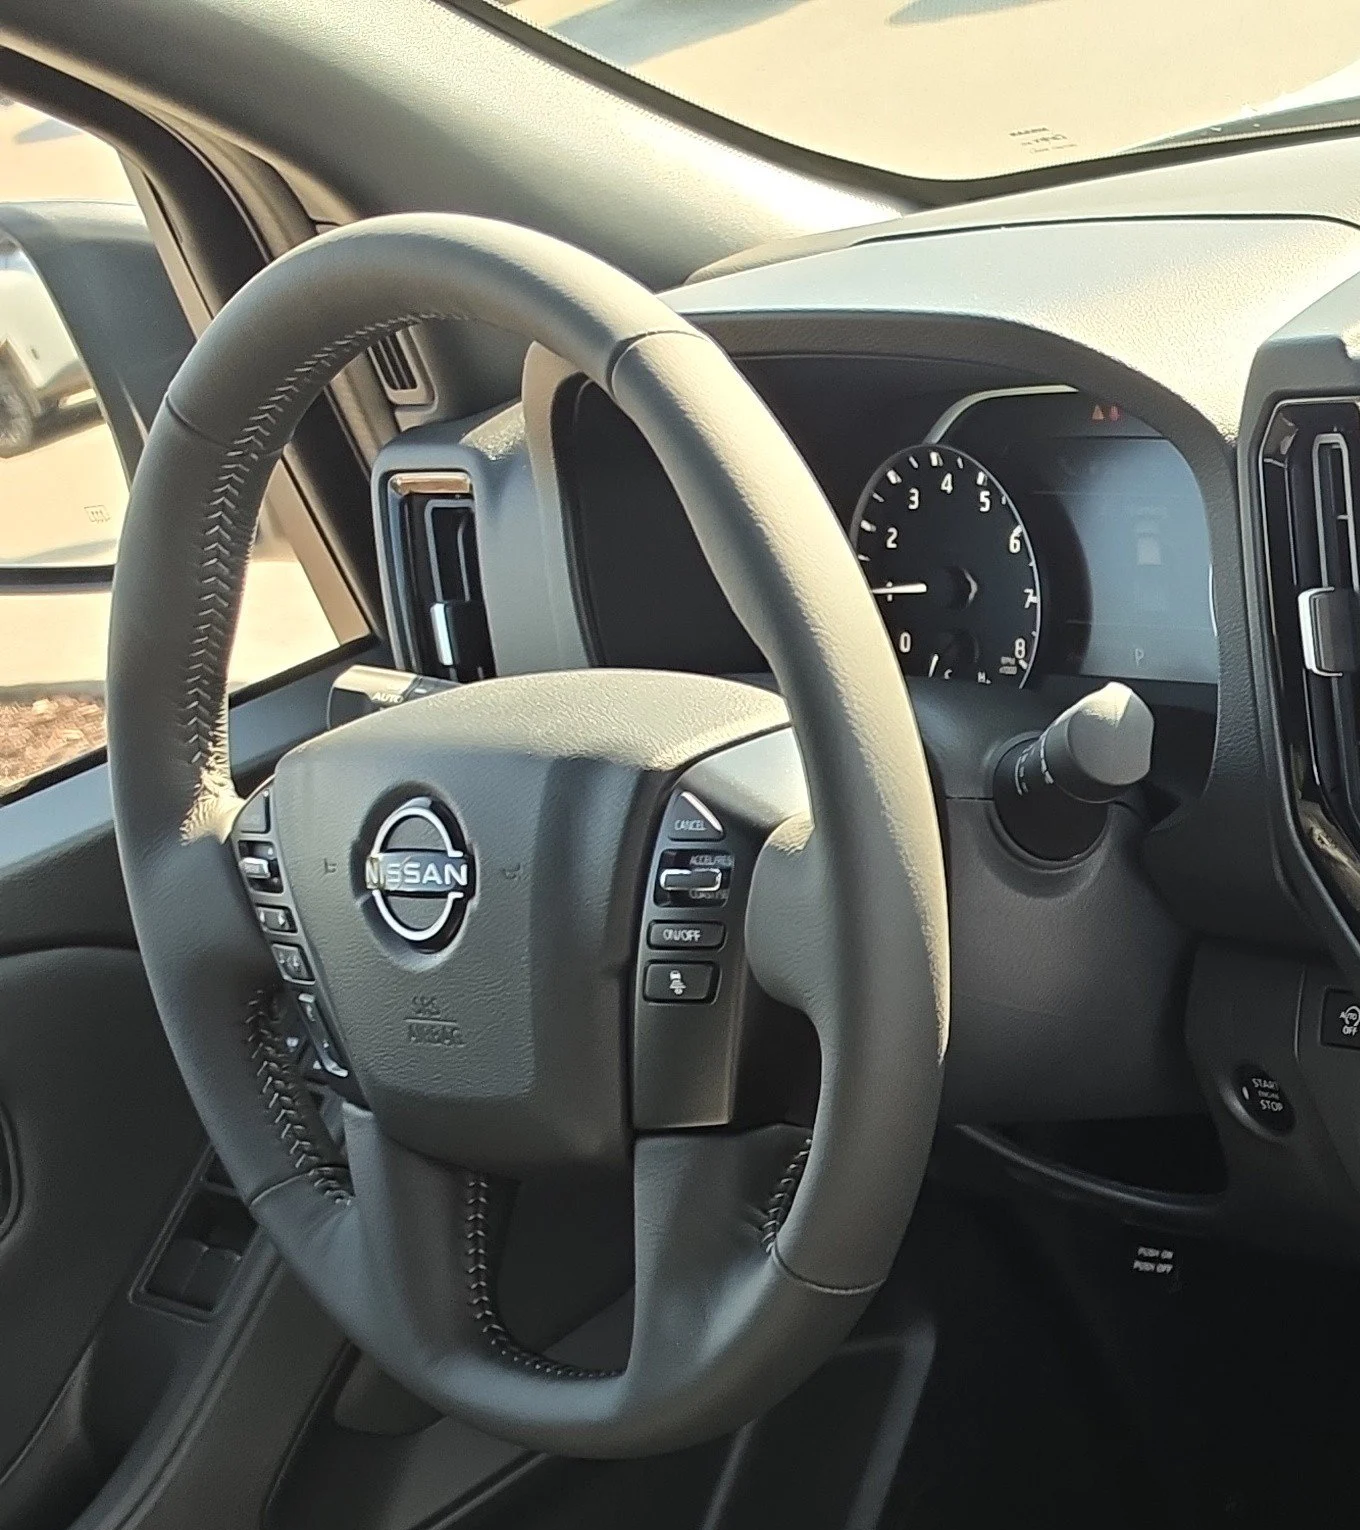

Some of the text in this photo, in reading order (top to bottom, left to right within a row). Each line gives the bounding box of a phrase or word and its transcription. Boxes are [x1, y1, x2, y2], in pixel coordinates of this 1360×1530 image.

[940, 472, 953, 494] 4
[908, 488, 920, 510] 3
[979, 490, 991, 513] 5
[886, 528, 898, 549] 2
[1009, 532, 1021, 554] 6
[899, 631, 911, 653] 0
[1014, 637, 1026, 659] 8
[365, 853, 469, 891] NISSAN
